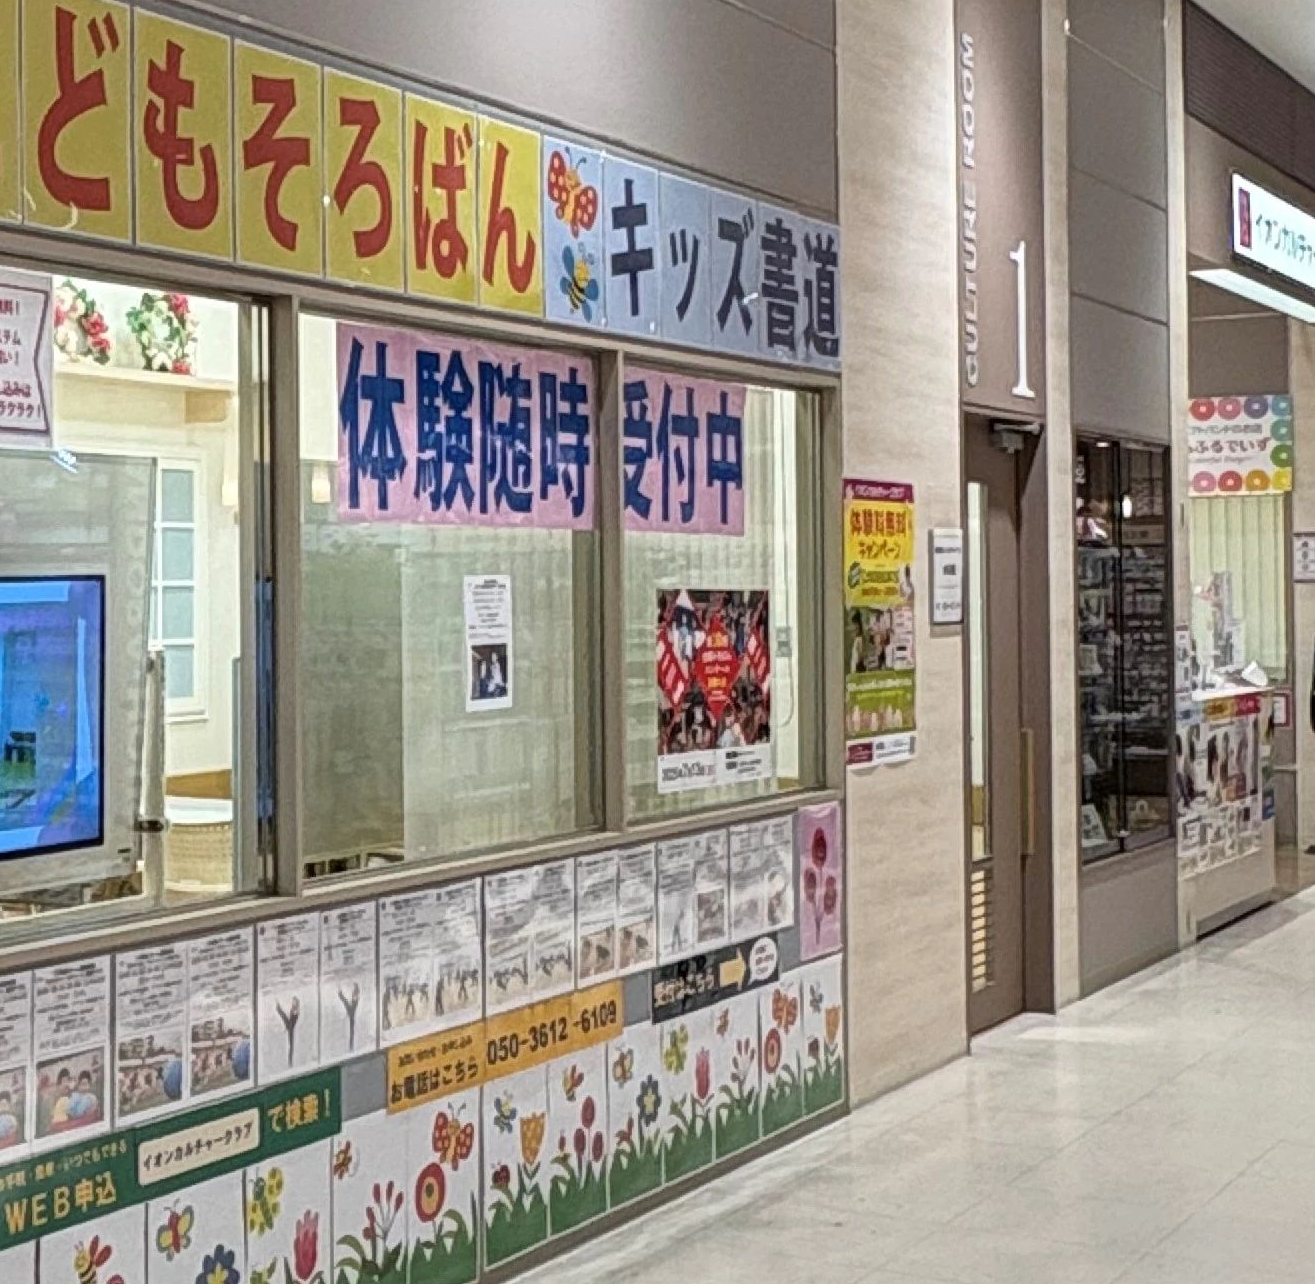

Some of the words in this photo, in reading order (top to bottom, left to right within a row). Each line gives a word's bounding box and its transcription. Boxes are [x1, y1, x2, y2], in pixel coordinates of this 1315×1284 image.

[610, 177, 840, 357] キッズ書道
[339, 336, 590, 518] 体験随時
